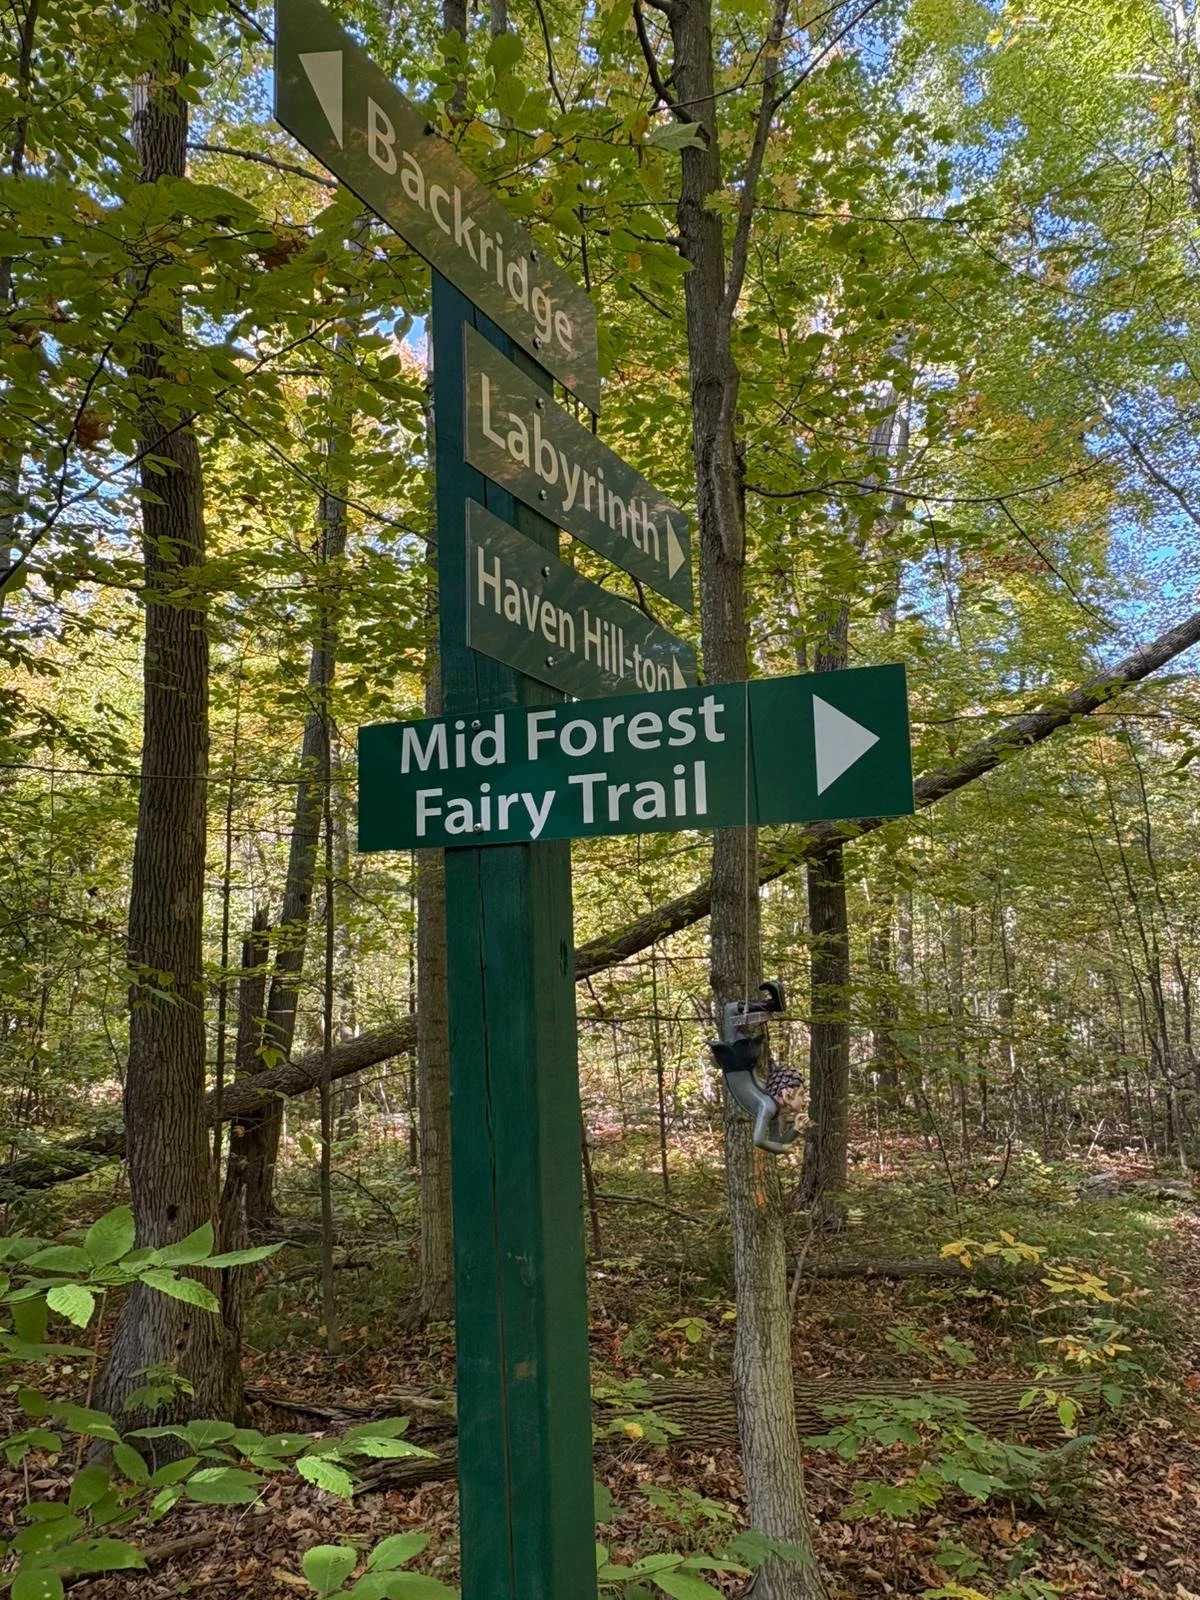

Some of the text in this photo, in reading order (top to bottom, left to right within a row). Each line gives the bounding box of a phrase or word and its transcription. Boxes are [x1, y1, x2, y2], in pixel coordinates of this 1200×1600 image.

[367, 96, 572, 353] Backridge
[481, 373, 660, 562] Labyrinth
[477, 546, 670, 693] Haven Hill-ton
[401, 695, 725, 774] Mid Forest
[415, 761, 708, 839] Fairy Trail
